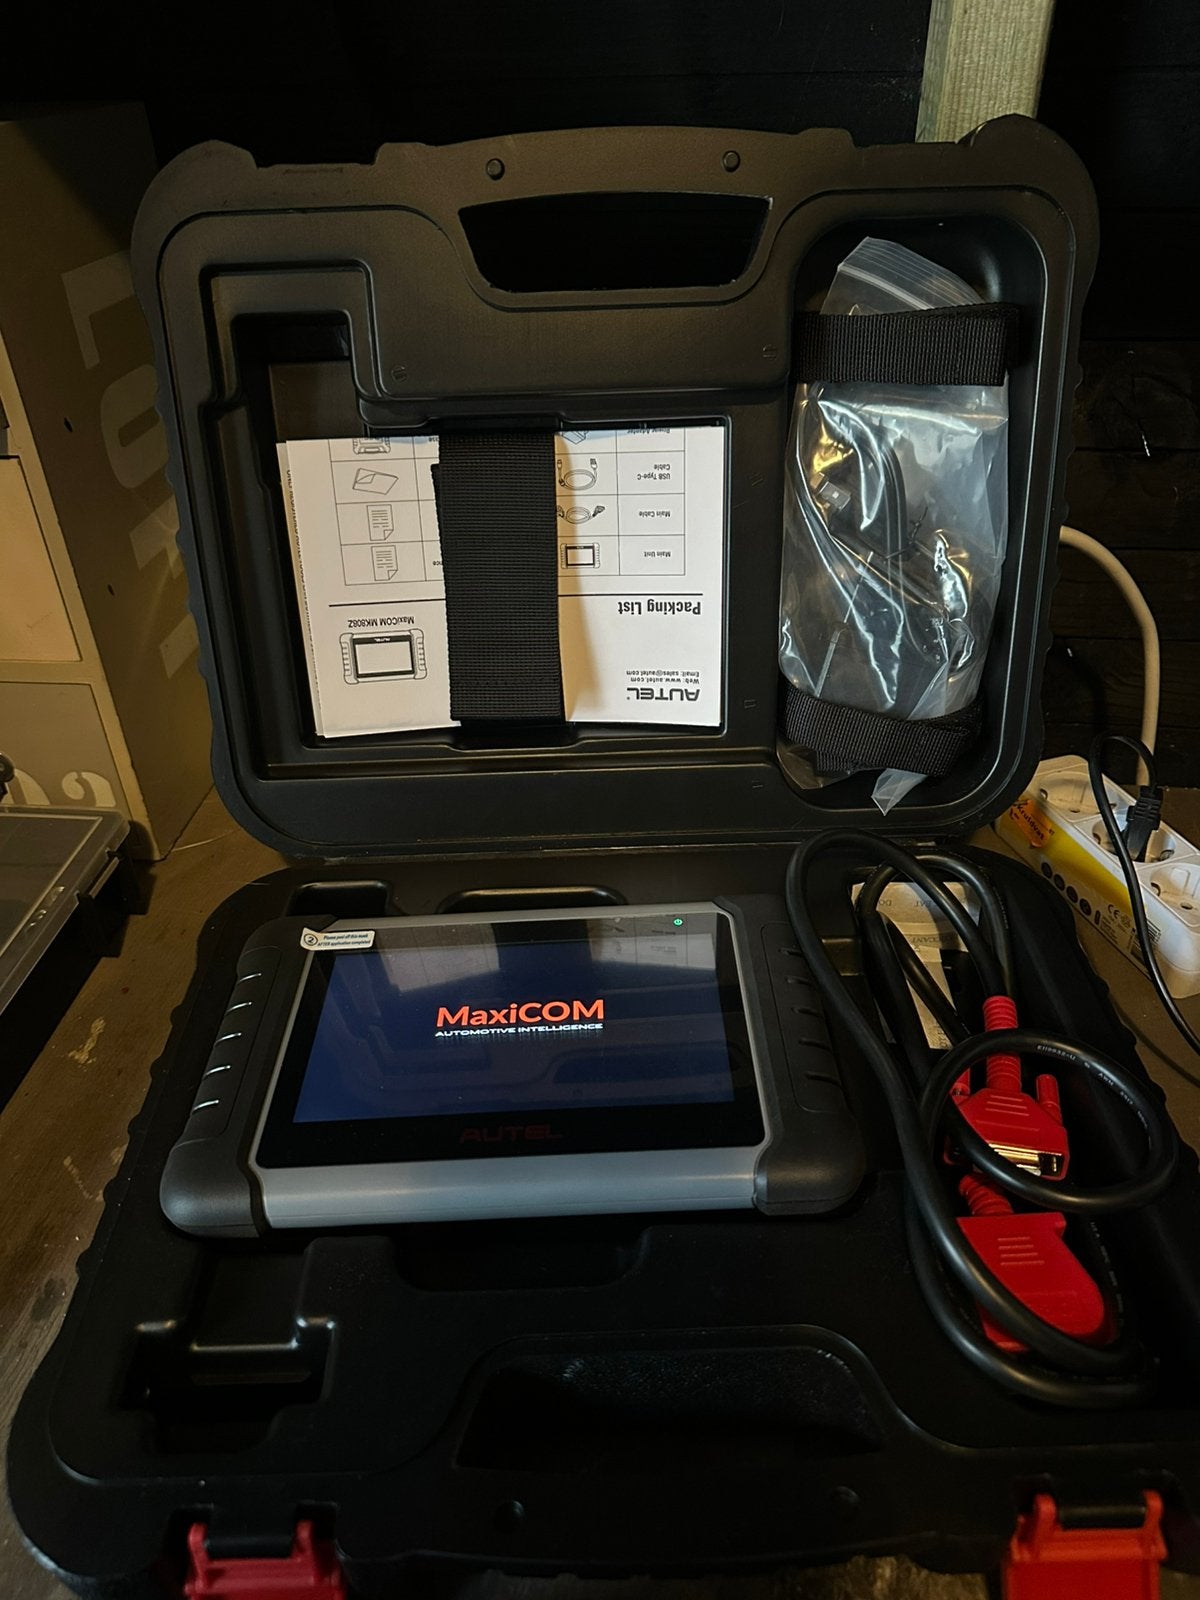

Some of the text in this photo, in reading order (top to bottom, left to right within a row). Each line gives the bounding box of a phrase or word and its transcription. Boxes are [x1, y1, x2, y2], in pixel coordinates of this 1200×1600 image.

[637, 472, 657, 480] Type-C
[617, 599, 702, 615] Packing List
[379, 615, 415, 625] MaxiCOM
[629, 687, 700, 702] AUTEL
[436, 998, 605, 1028] MaxiCOM
[434, 1023, 604, 1038] AUTOMOTIVE INTELLIGENCE
[459, 1123, 562, 1144] AUTEL
